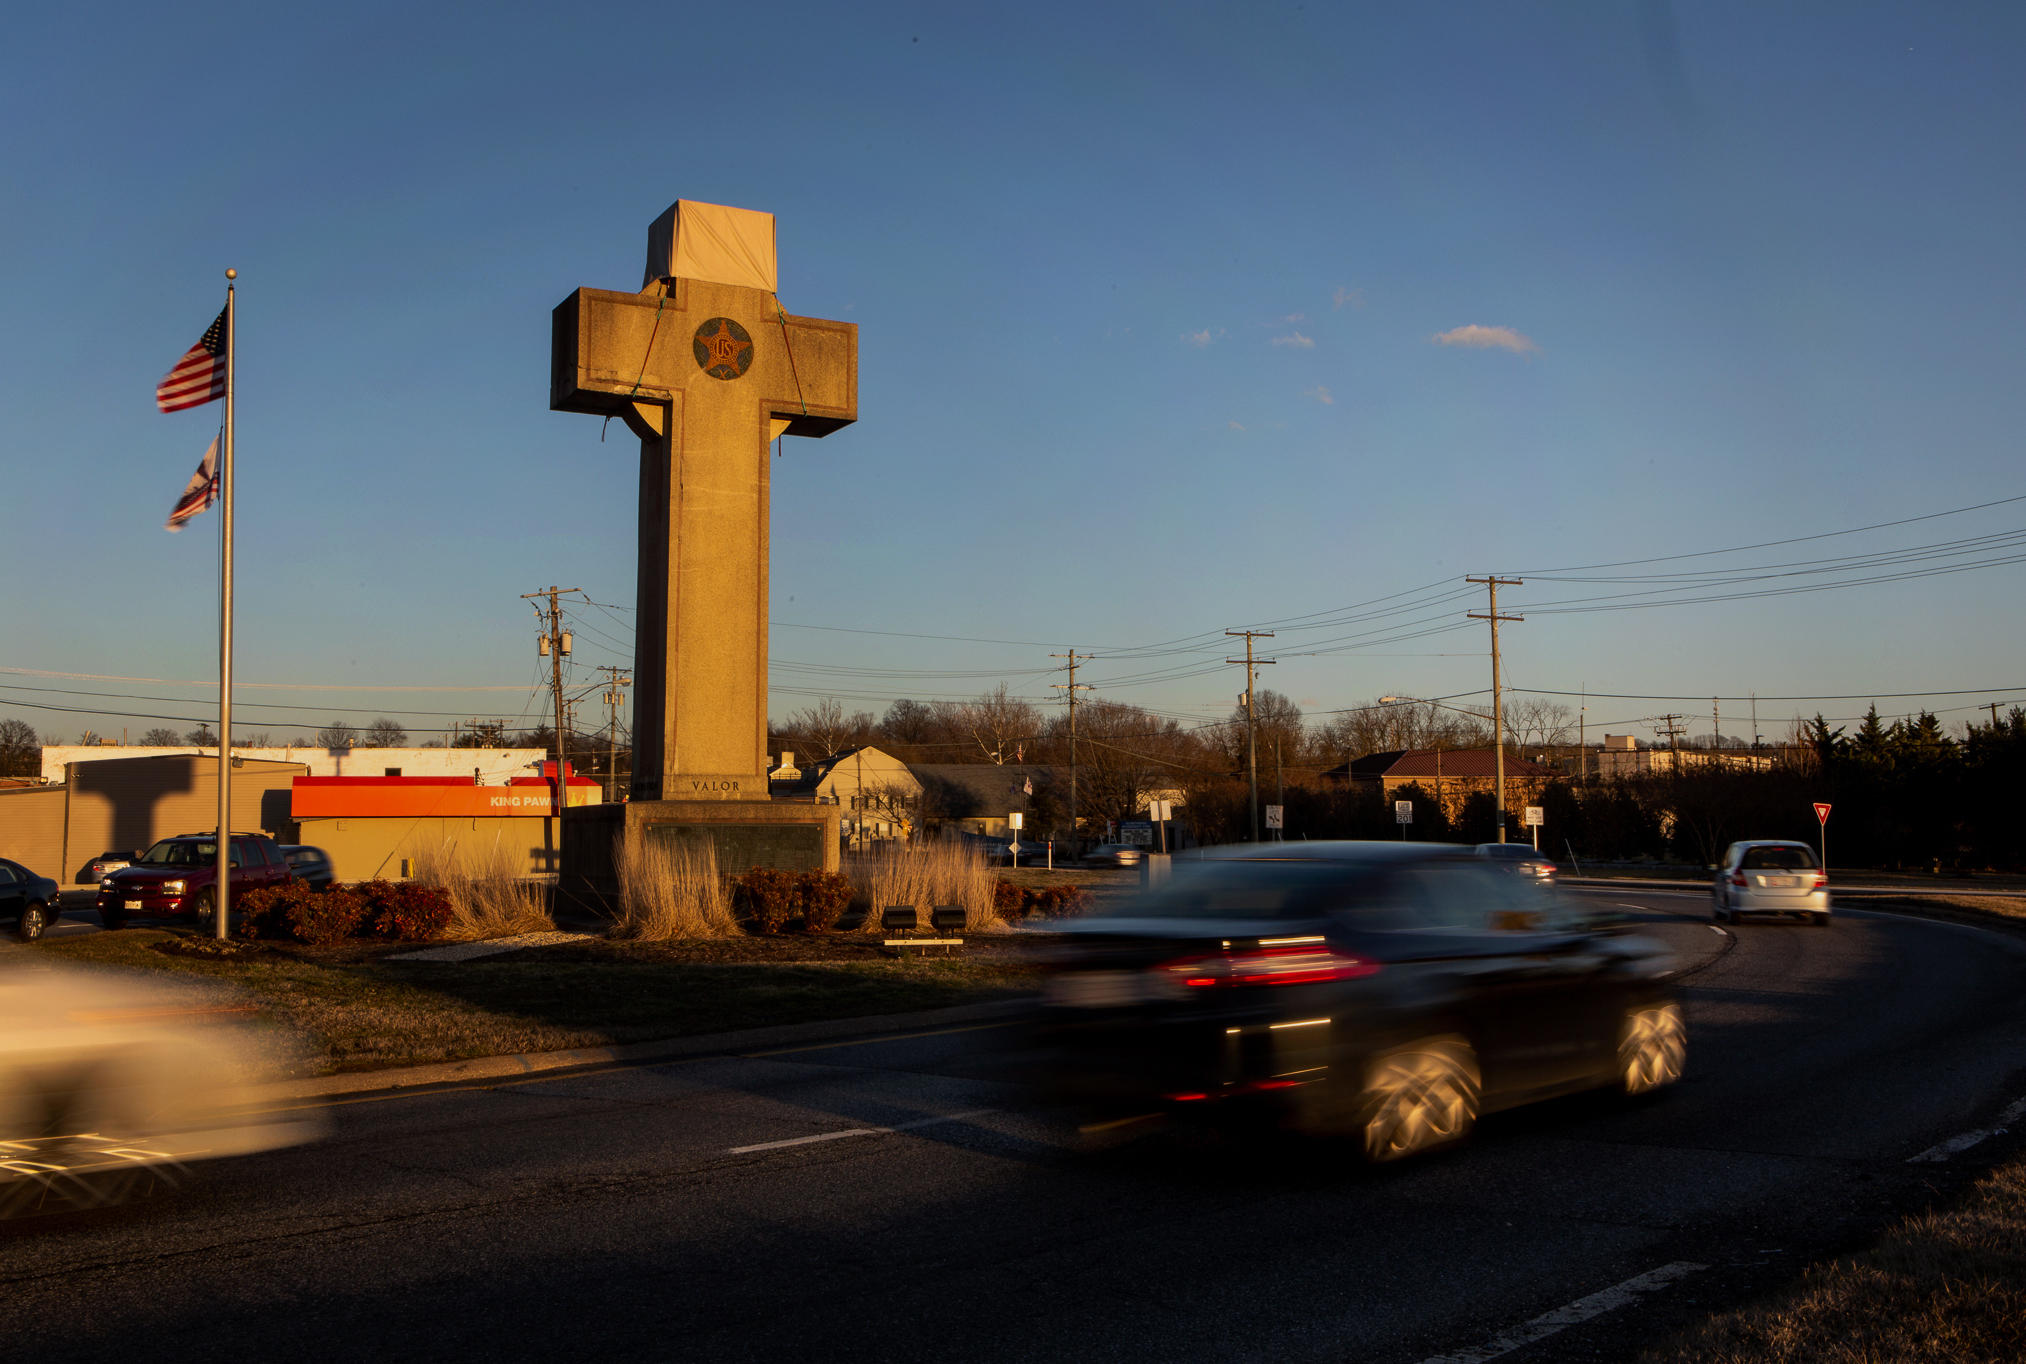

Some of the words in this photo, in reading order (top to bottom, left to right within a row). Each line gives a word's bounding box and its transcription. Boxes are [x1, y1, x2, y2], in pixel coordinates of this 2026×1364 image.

[693, 781, 739, 791] VALOR
[490, 796, 520, 807] KING
[524, 796, 558, 807] PAWN
[1397, 815, 1412, 823] 201
